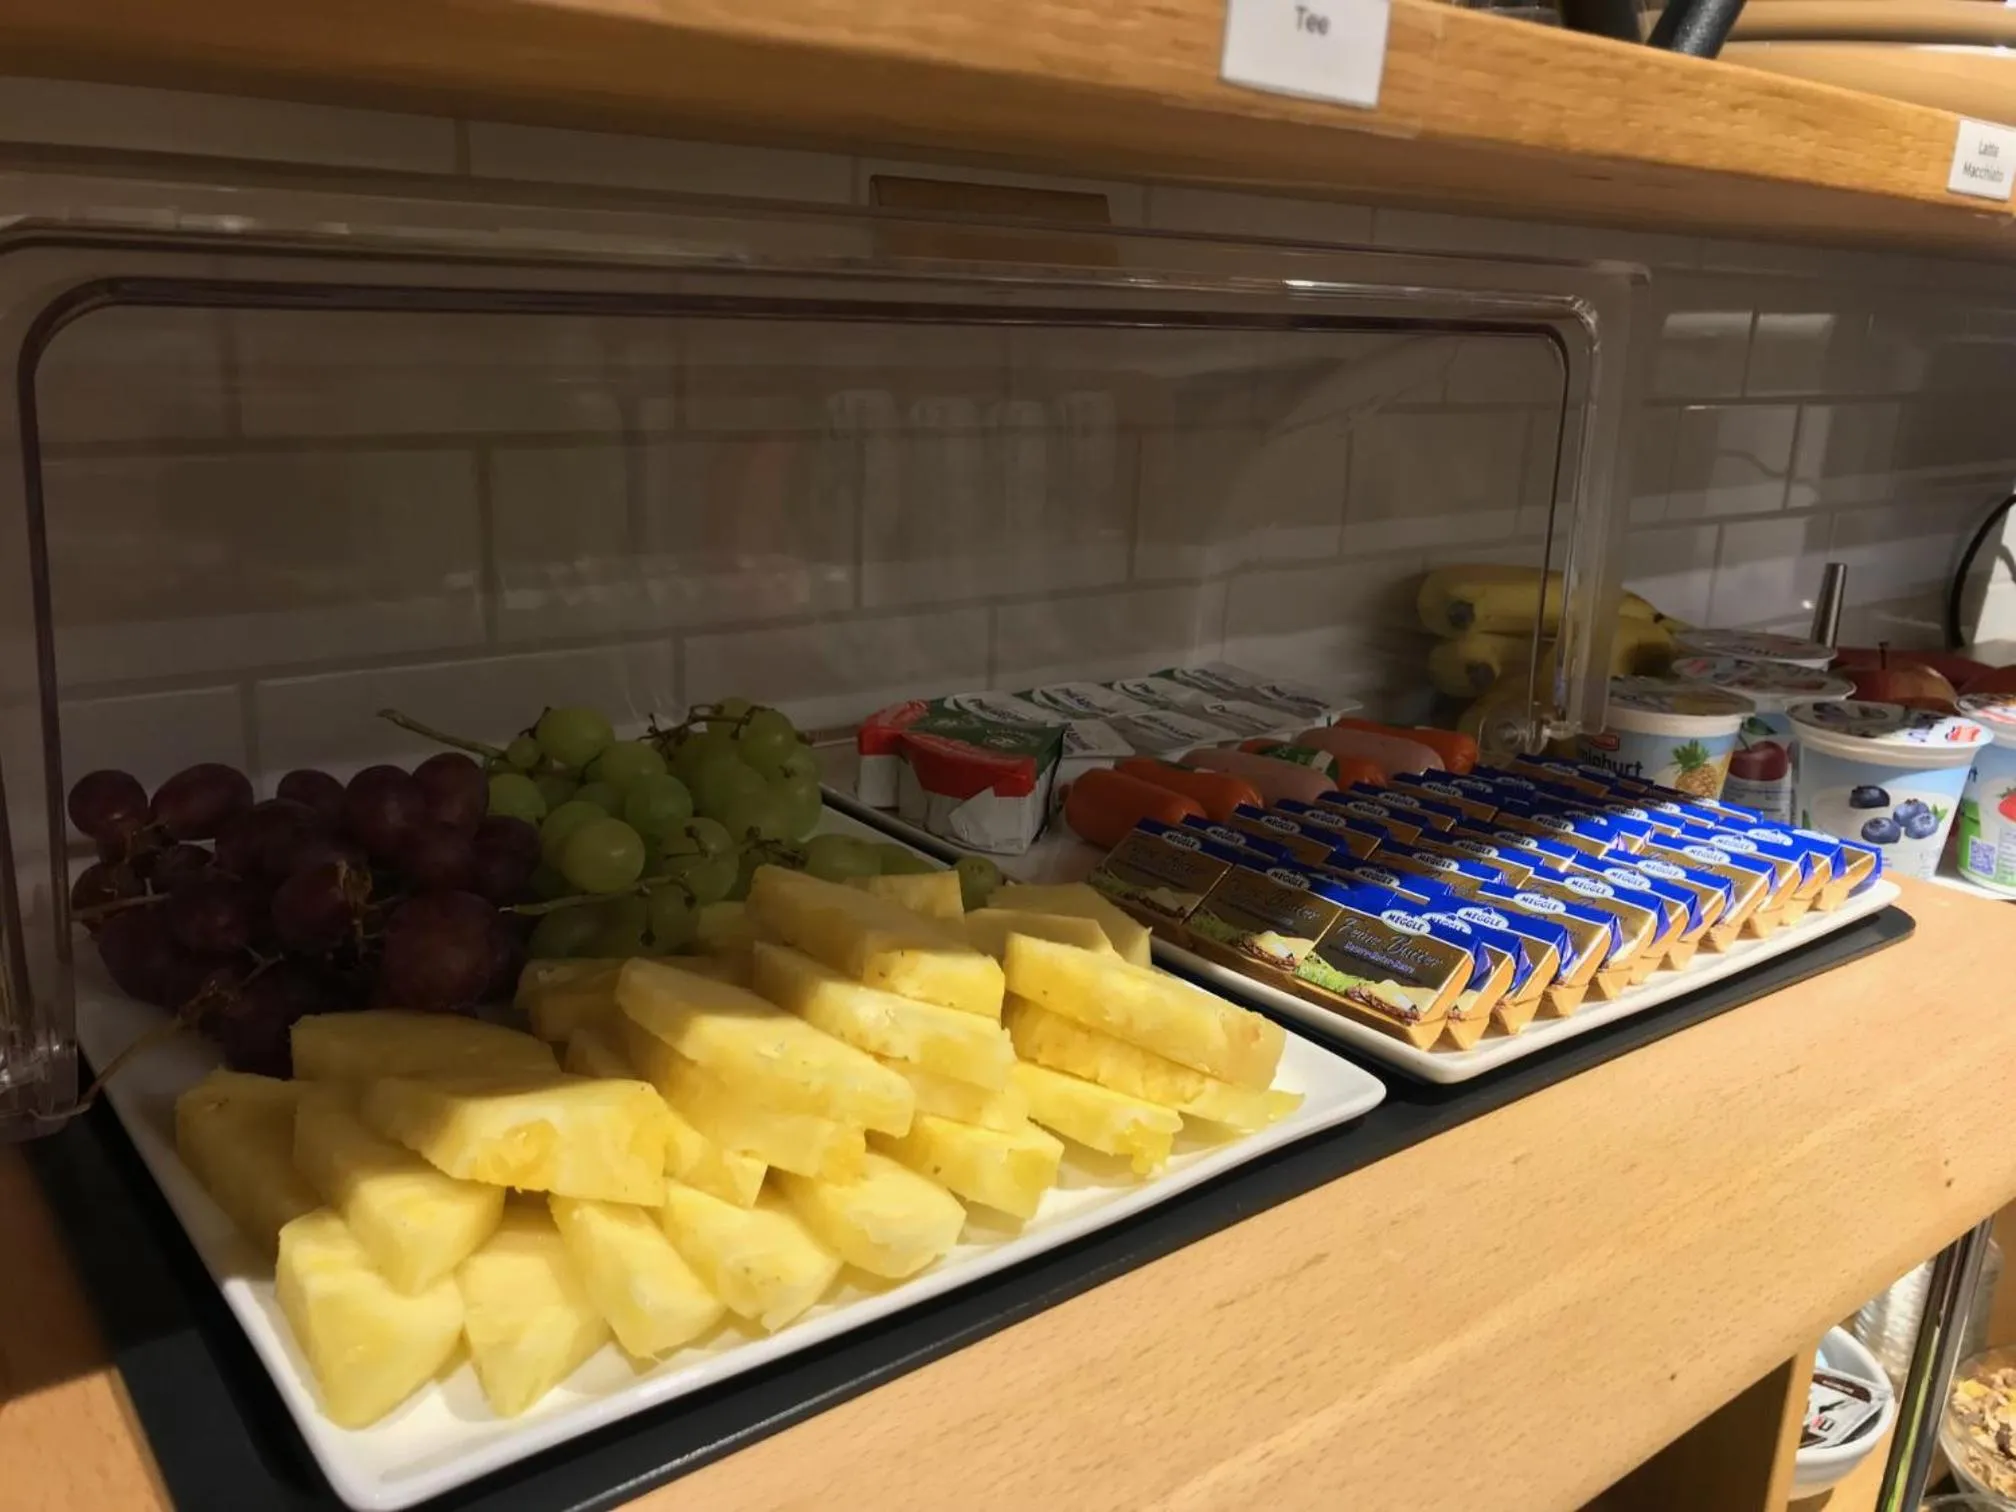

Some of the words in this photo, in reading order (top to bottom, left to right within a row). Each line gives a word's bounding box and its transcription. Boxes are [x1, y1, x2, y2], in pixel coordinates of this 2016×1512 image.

[1296, 5, 1330, 35] Tee
[1265, 817, 1298, 834] MEGGLE
[1460, 843, 1495, 857] MEGGLE
[1644, 862, 1681, 877] MEGGLE
[1271, 870, 1308, 888] MEGGLE
[1612, 870, 1646, 887] MEGGLE
[1572, 880, 1608, 896] MEGGLE
[1521, 895, 1559, 912] MEGGLE
[1387, 912, 1425, 931] MEGGLE
[1465, 909, 1501, 928] MEGGLE
